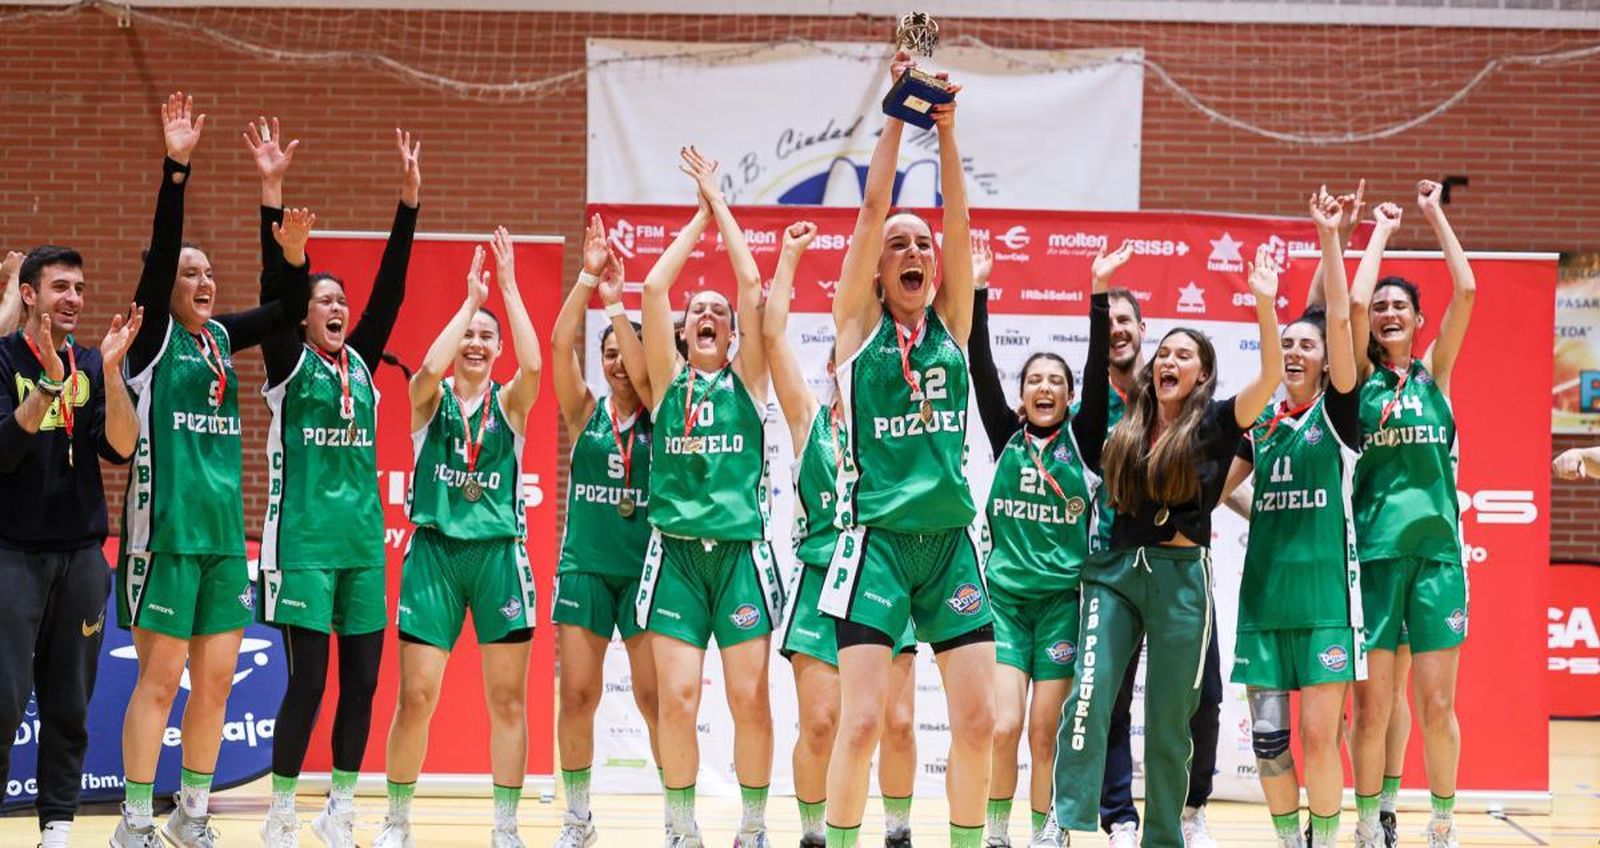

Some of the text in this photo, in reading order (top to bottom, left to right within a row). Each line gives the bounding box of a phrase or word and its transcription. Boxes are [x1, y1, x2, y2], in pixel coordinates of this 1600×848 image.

[776, 116, 864, 159] Ciudad
[636, 225, 665, 237] FBM
[1048, 232, 1107, 248] molten
[1270, 455, 1293, 483] 11
